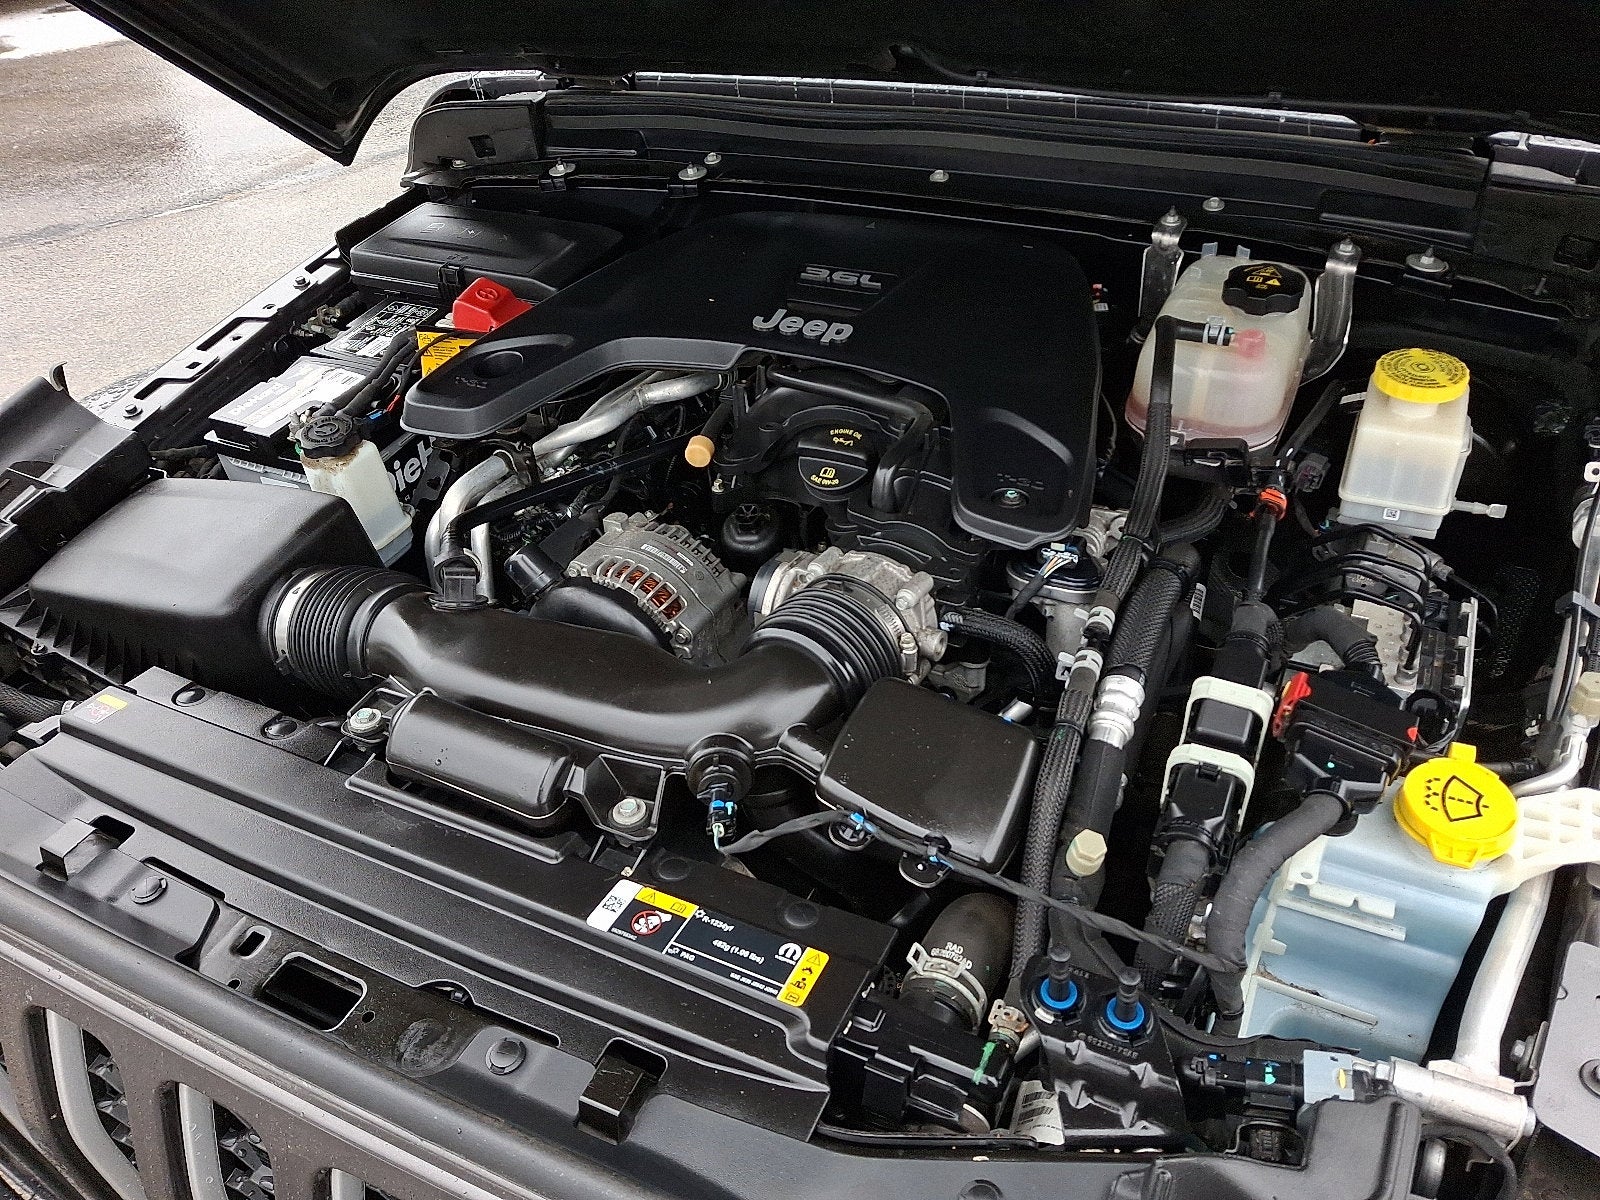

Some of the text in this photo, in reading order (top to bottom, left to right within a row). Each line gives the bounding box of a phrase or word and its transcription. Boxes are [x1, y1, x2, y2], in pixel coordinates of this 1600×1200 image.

[800, 266, 882, 290] 3.6L
[752, 308, 854, 345] Jeep
[830, 428, 854, 436] ENGINE
[945, 941, 964, 954] RAD
